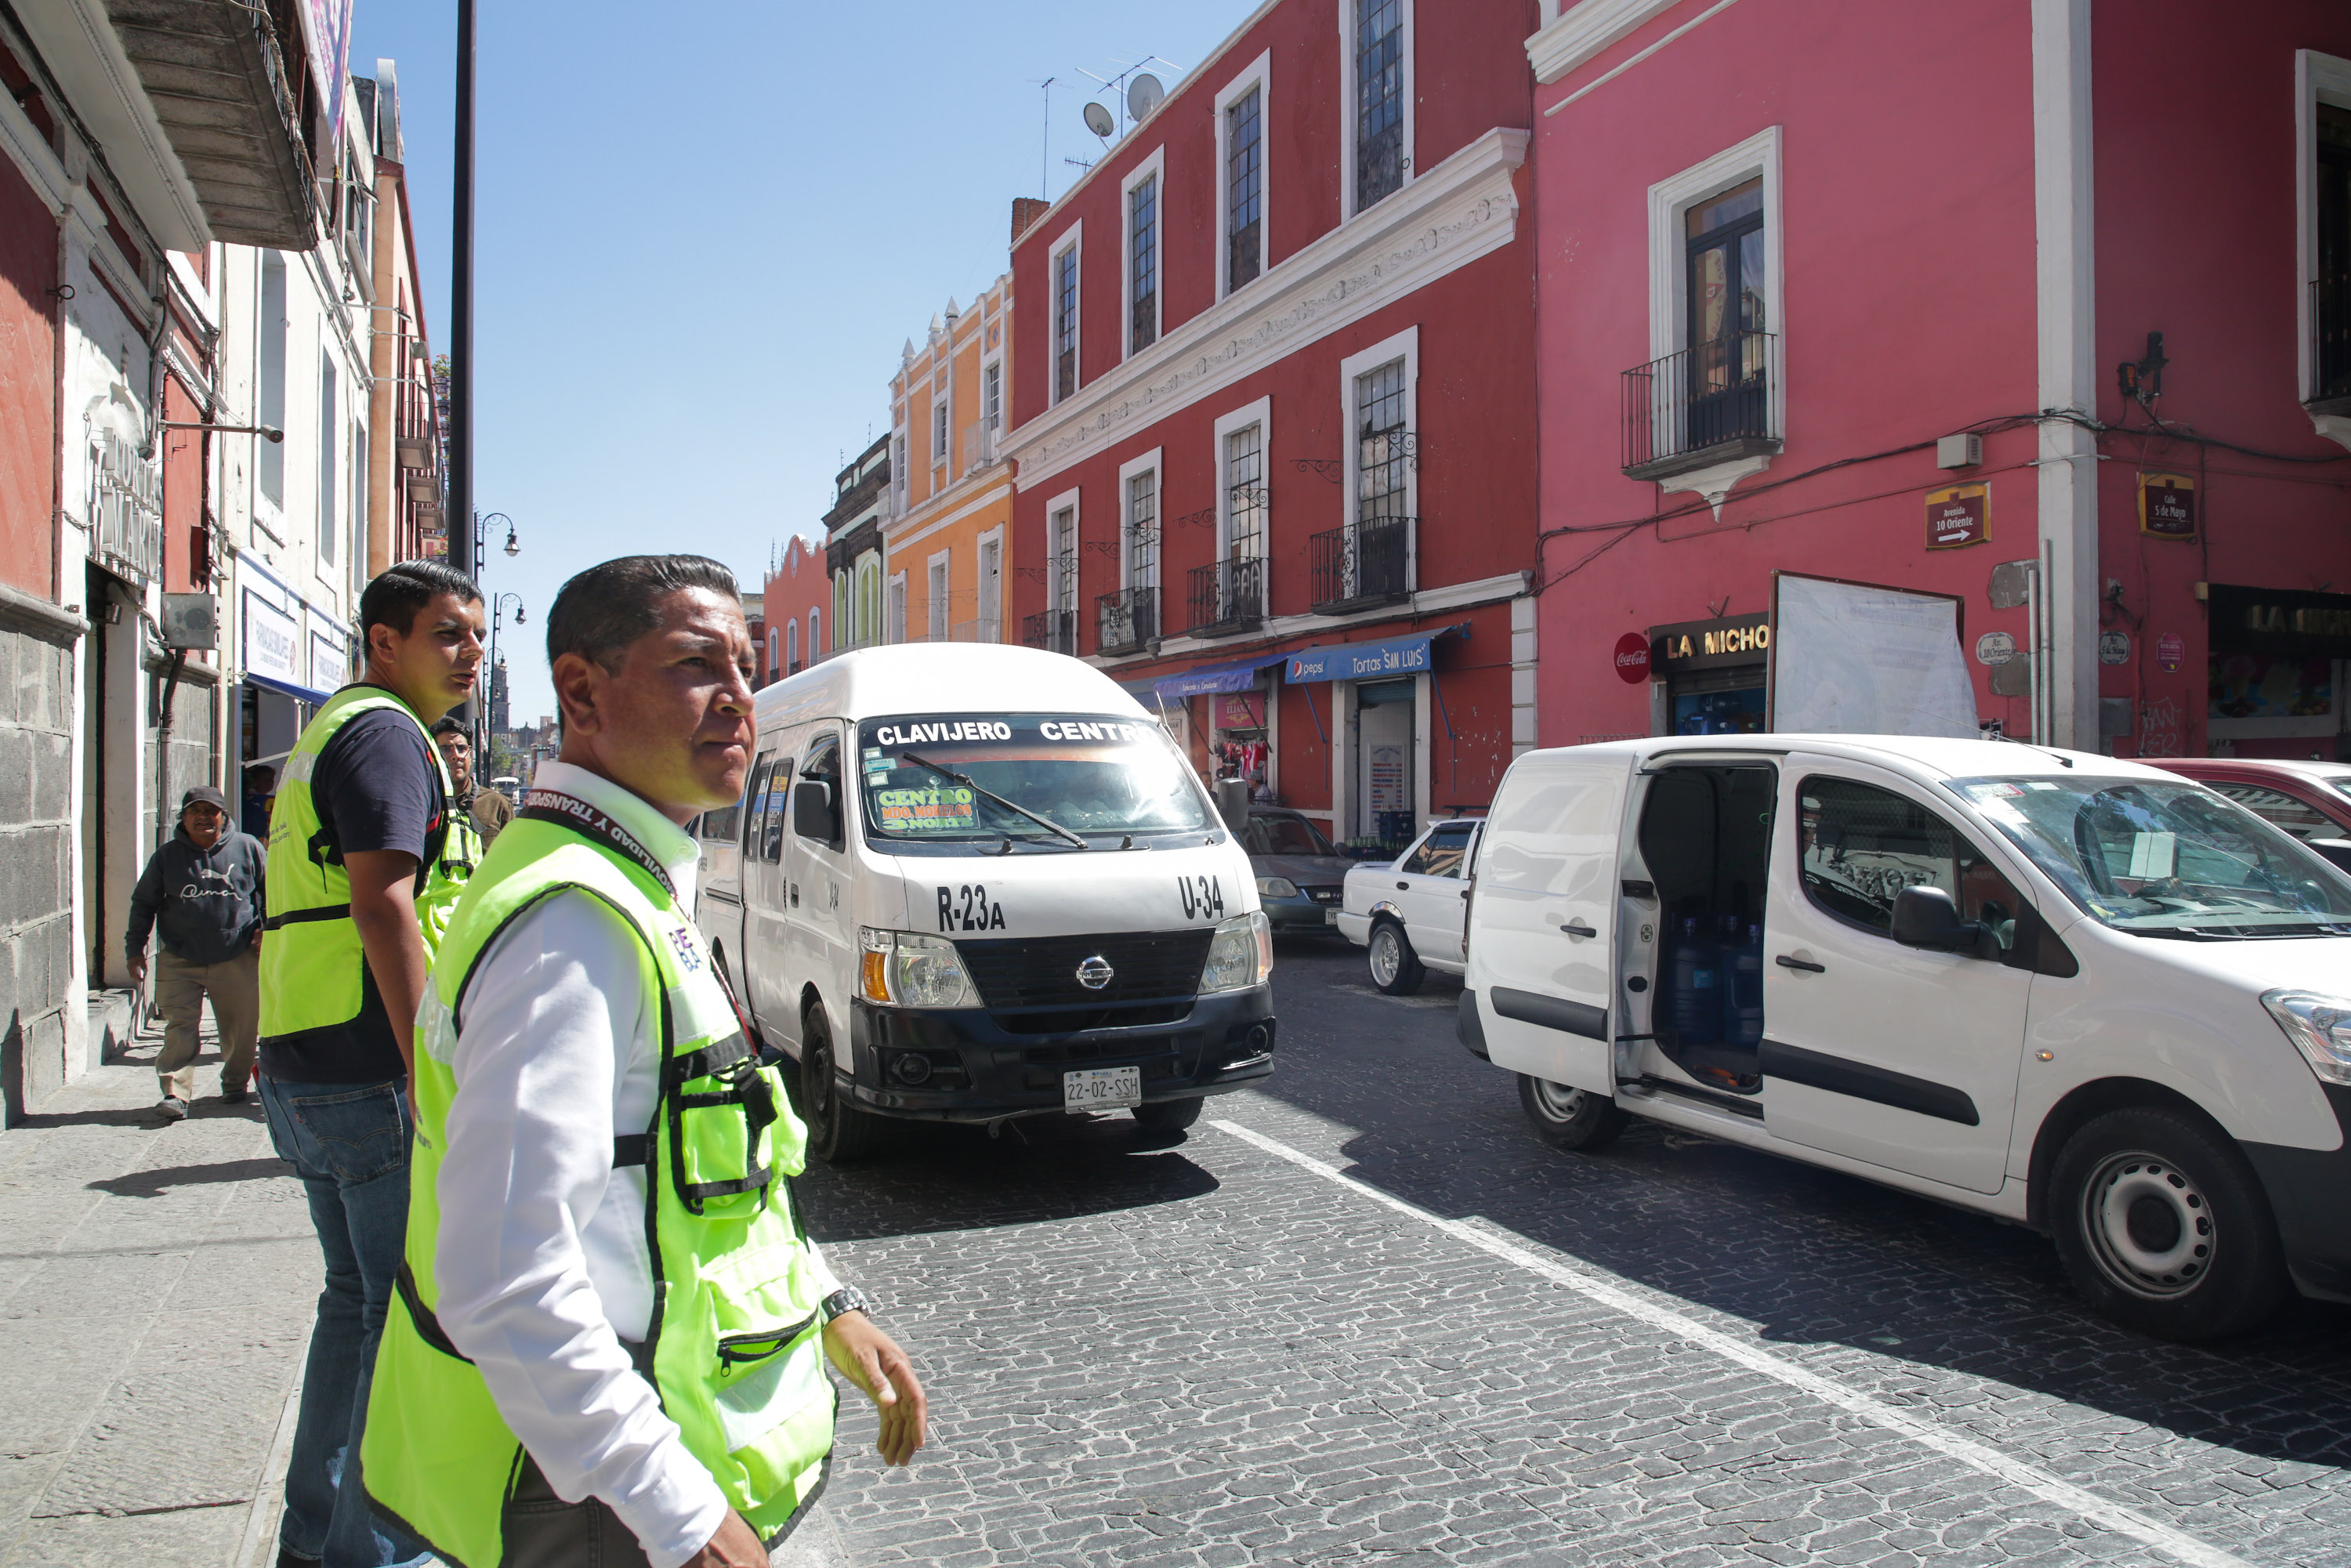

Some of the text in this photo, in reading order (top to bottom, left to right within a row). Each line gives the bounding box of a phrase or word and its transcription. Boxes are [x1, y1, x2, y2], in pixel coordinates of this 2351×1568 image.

[2164, 494, 2176, 504] Calle
[1943, 506, 1965, 517] Avenida
[2155, 505, 2186, 520] 5 de Mayo
[1936, 516, 1973, 531] 10 Oriente
[1667, 625, 1770, 659] LA MICHO
[1353, 657, 1381, 674] Tortas
[1617, 650, 1648, 667] Coca-Cola
[1303, 661, 1324, 676] pepsi
[877, 722, 1156, 745] CLAVIJERO CENTRO
[878, 788, 973, 806] CENTRO
[882, 804, 973, 820] MDO. MORELOS
[594, 817, 607, 831] Y
[882, 817, 974, 830] 3 NORTE
[610, 826, 676, 894] MOVILIDAD
[829, 881, 840, 911] U-34
[1177, 875, 1225, 920] U-34
[936, 885, 1006, 932] R-23A
[1081, 970, 1111, 979] NISSAN
[1067, 1077, 1139, 1100] 22-02-SSH
